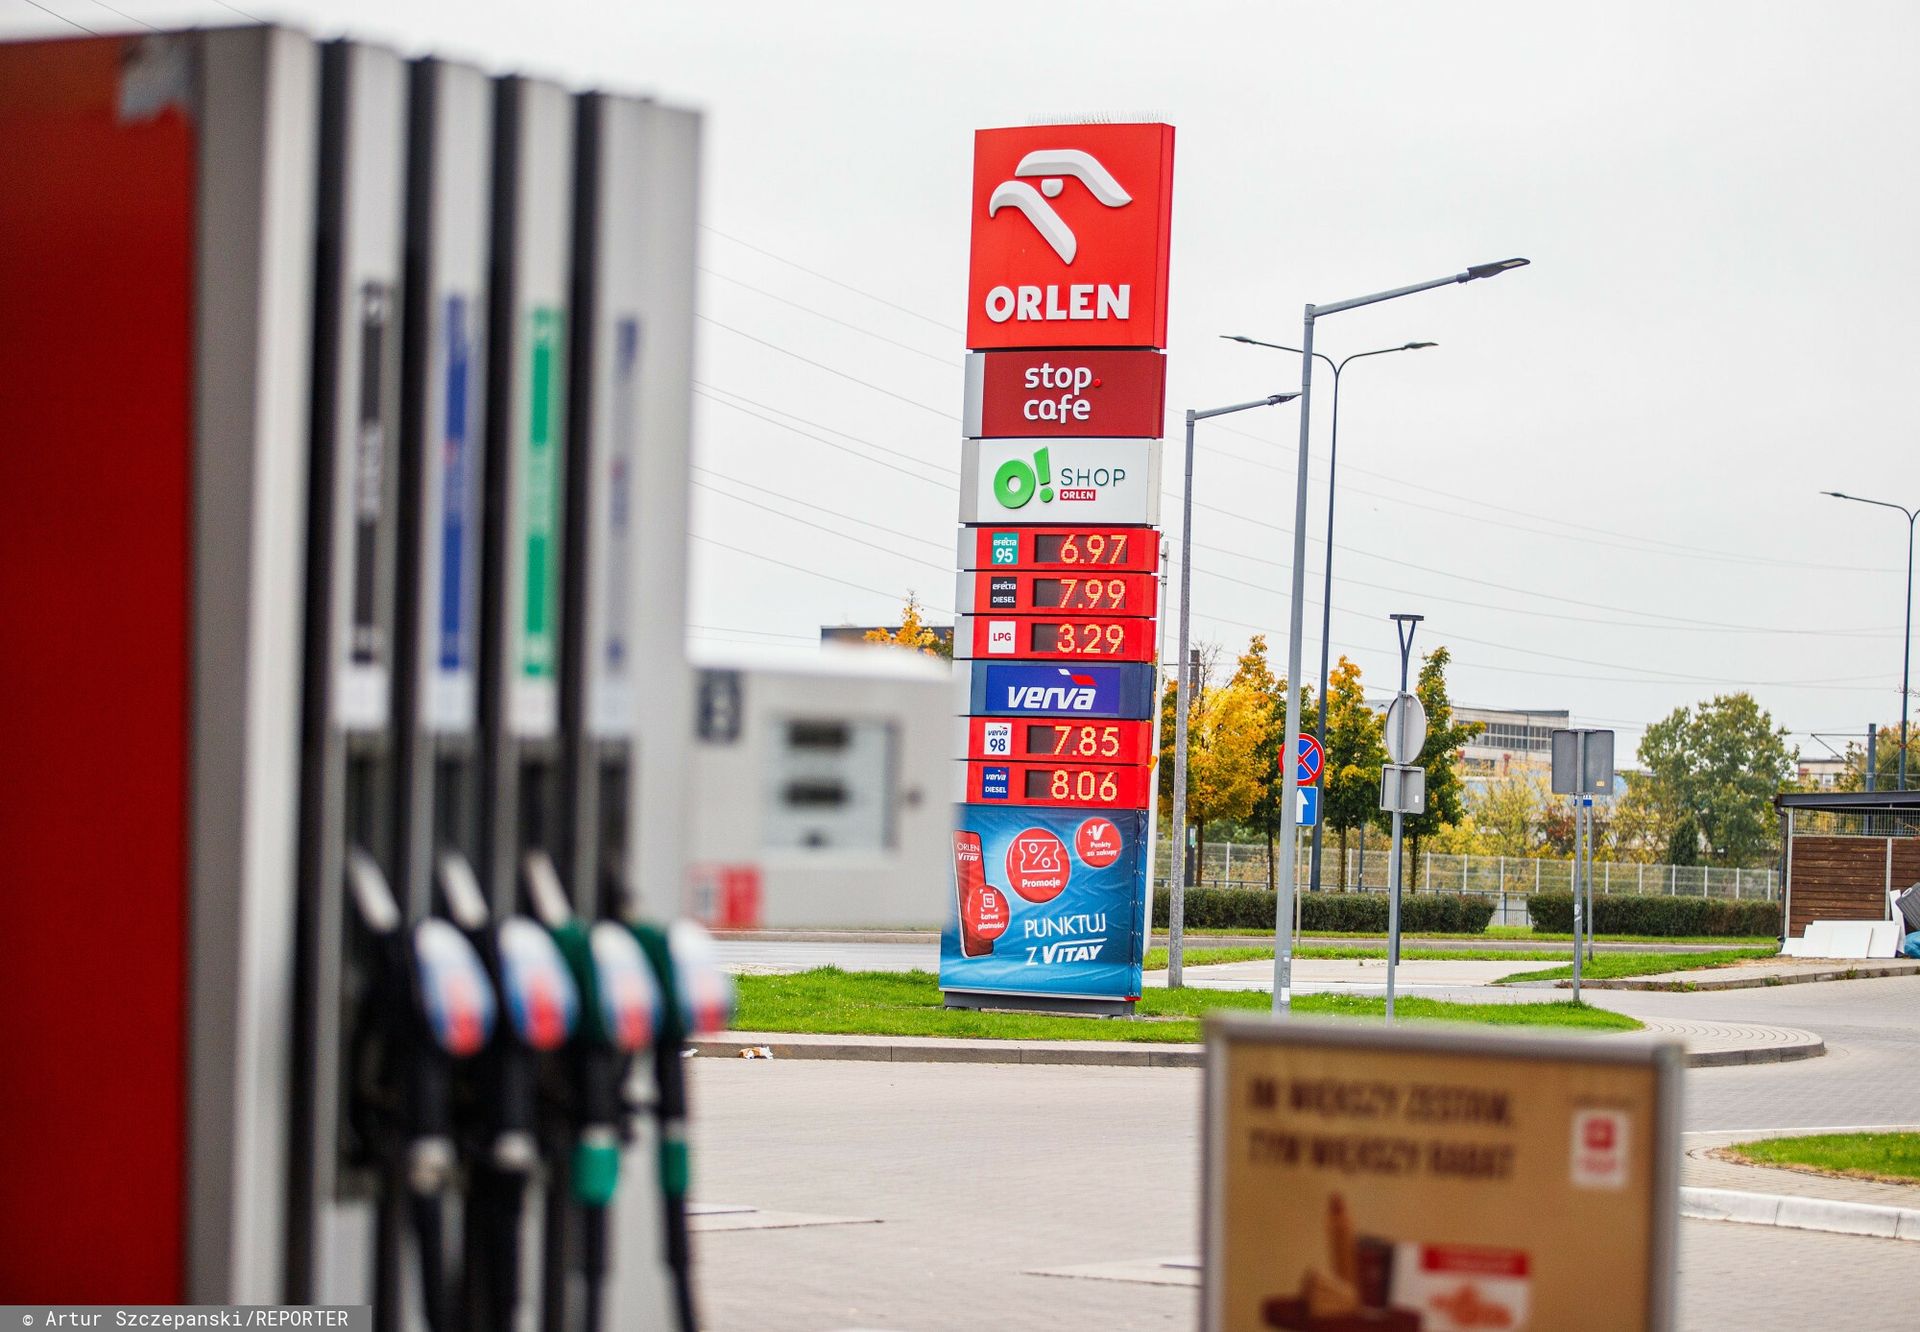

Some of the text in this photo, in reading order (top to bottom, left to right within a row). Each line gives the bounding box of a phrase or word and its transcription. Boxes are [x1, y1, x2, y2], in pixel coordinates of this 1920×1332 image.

[985, 284, 1131, 323] ORLEN
[1023, 393, 1091, 424] cafe
[1060, 467, 1126, 488] SHOP
[1061, 490, 1095, 501] ORLEN
[995, 547, 1014, 564] 95
[1060, 534, 1128, 565] 6.97
[992, 596, 1016, 604] DIESEL
[1060, 579, 1126, 609] 7.99
[993, 632, 1012, 642] LPG
[1057, 624, 1125, 655] 3.29
[1008, 686, 1096, 710] verva
[989, 738, 1006, 753] 98
[1053, 725, 1120, 757] 7.85
[1051, 769, 1118, 802] 8.06
[957, 843, 980, 852] ORLEN
[957, 852, 981, 862] VITAY
[1022, 878, 1061, 889] Promocje
[1024, 913, 1107, 939] PUNKTUJ
[1042, 937, 1108, 965] VITAY
